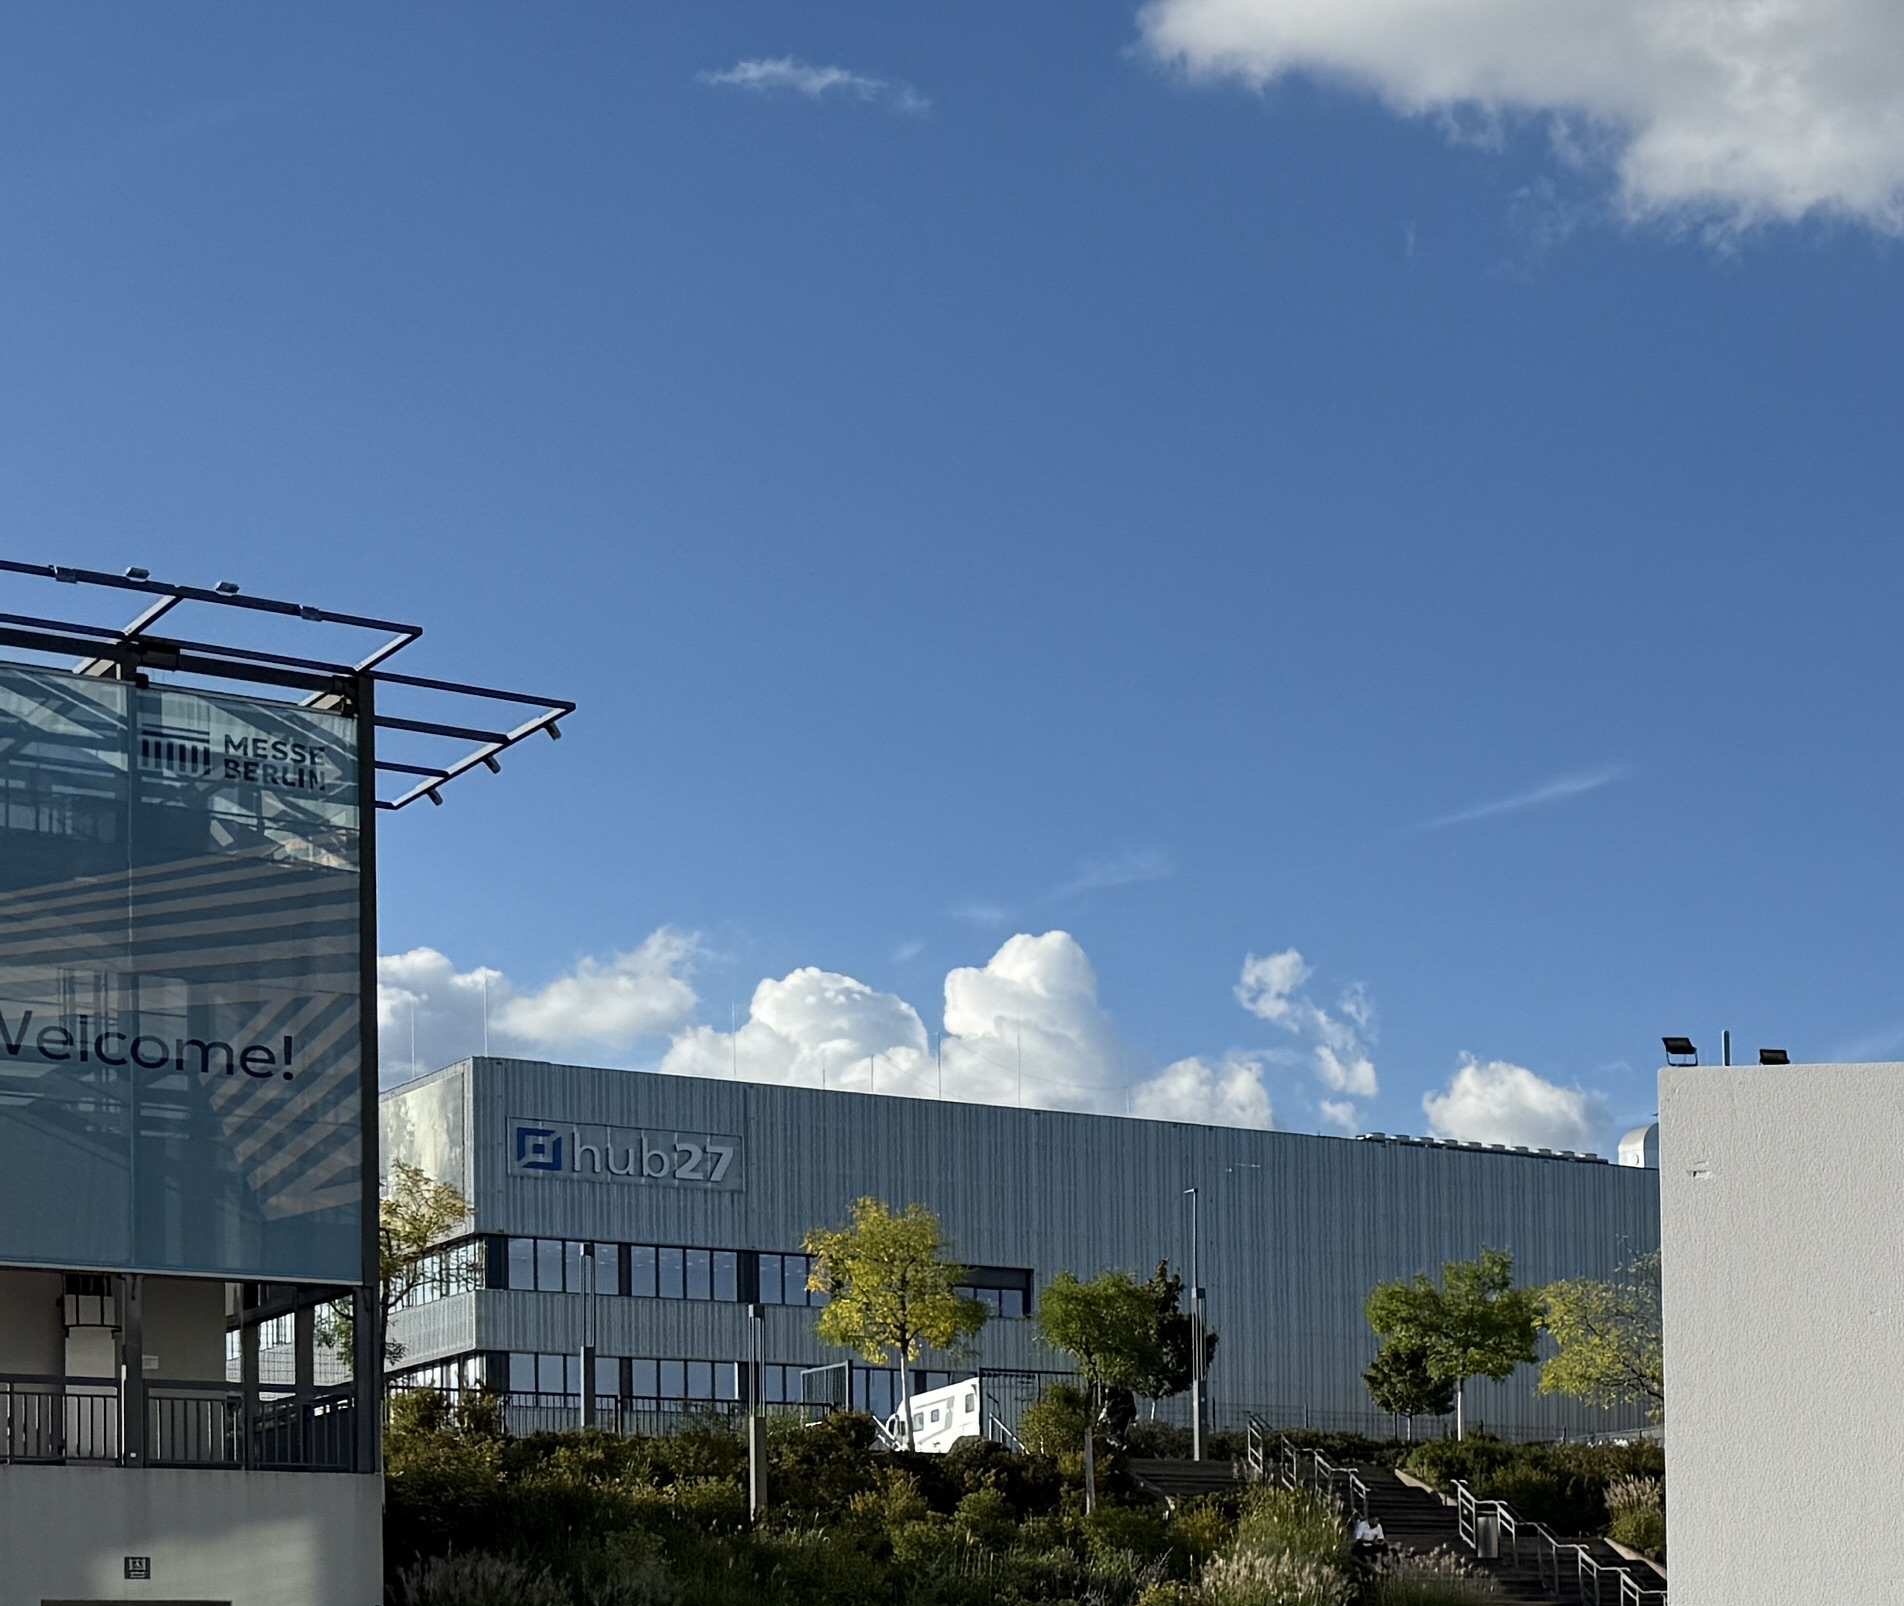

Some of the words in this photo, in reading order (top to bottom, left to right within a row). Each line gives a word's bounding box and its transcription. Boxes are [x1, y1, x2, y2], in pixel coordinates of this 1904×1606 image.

[224, 734, 326, 766] MESSE
[224, 758, 326, 791] BERLIN
[573, 1127, 734, 1182] hub27
